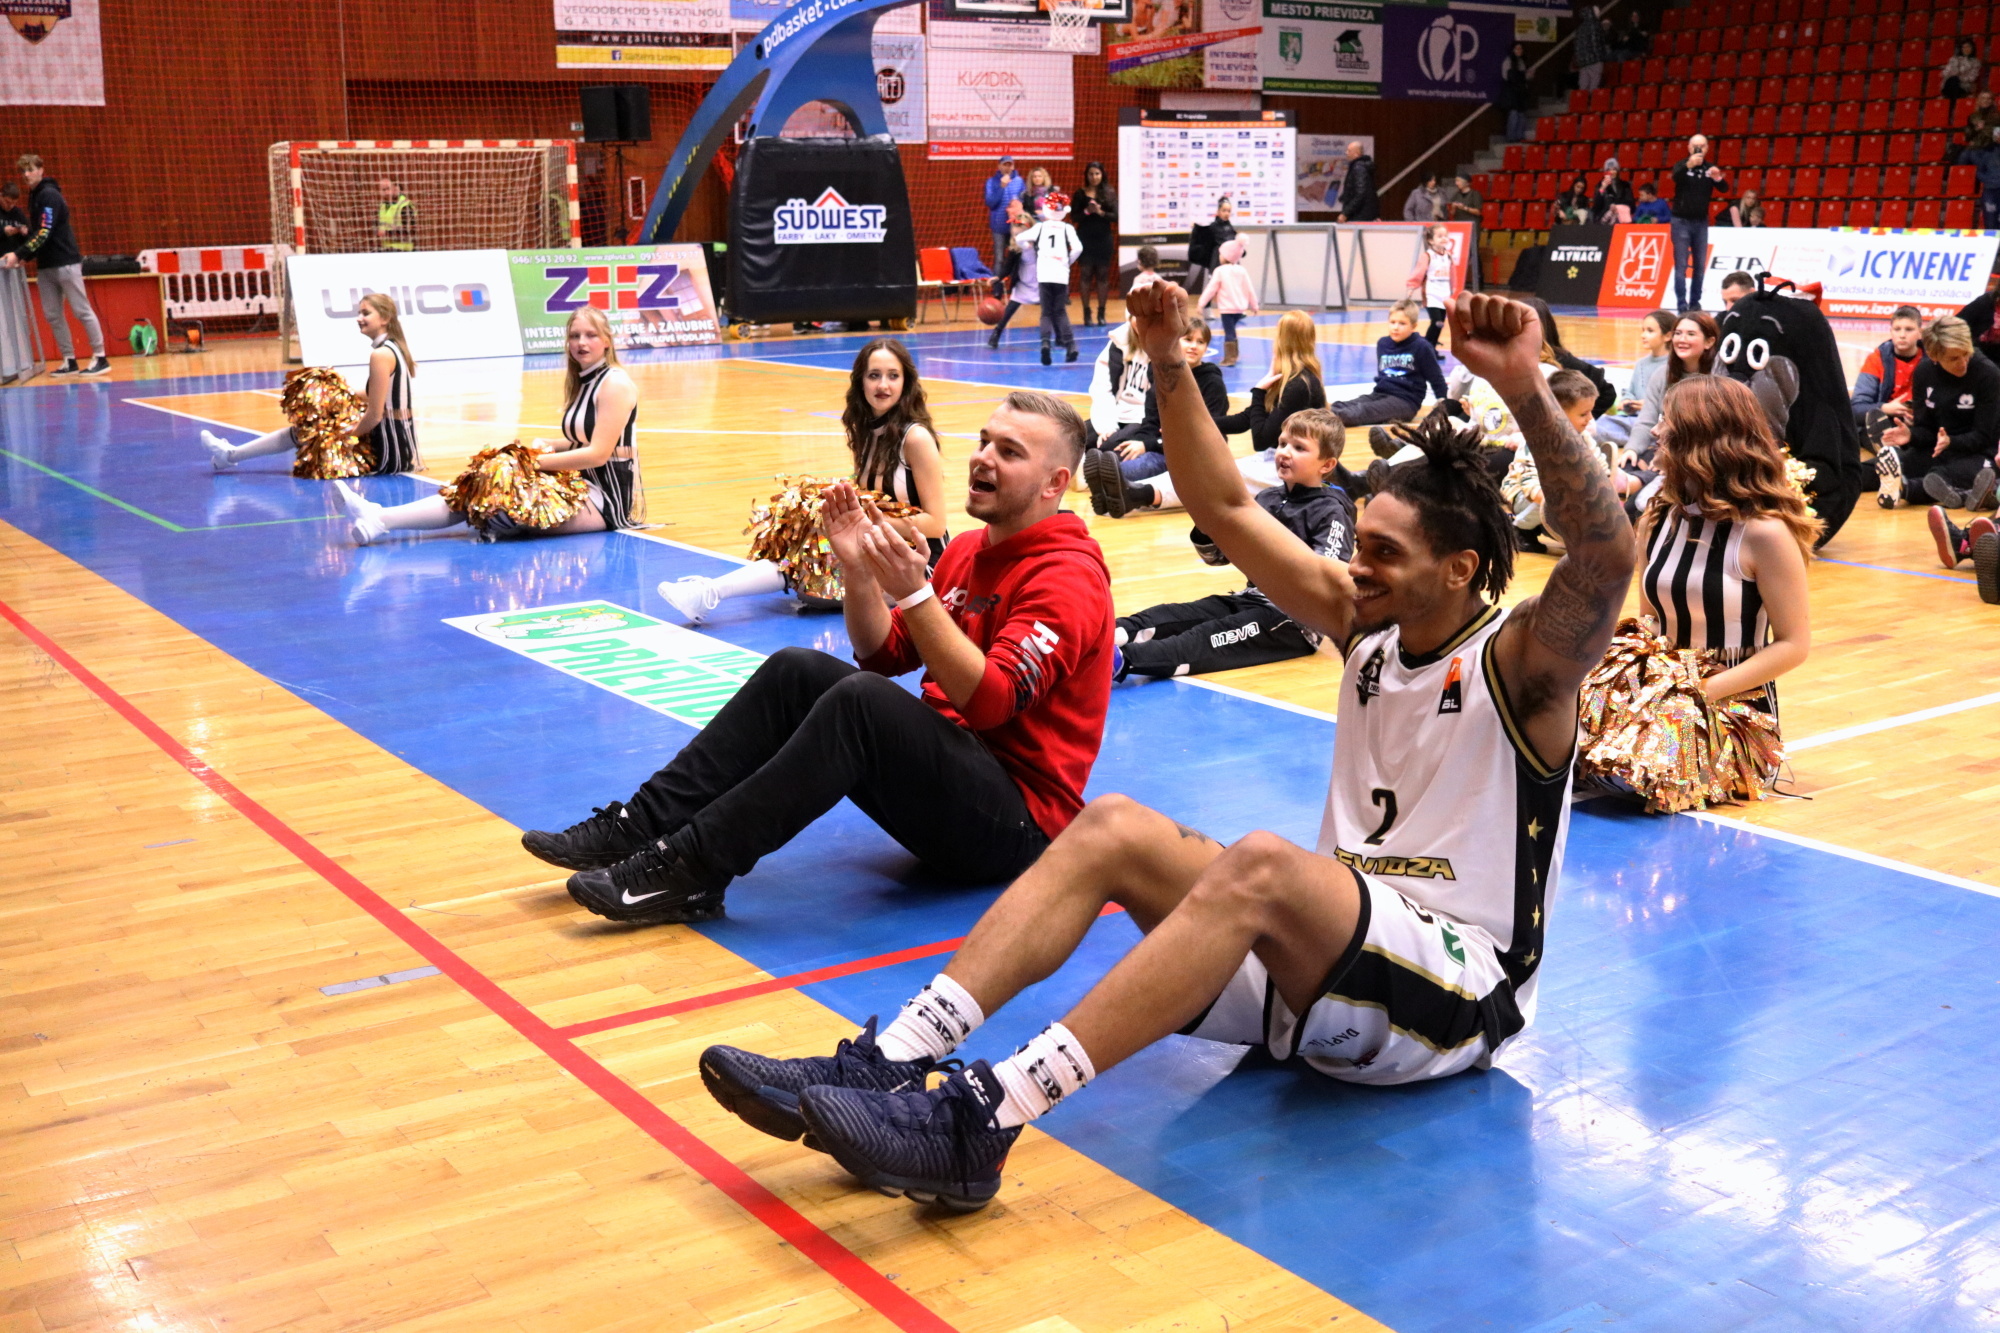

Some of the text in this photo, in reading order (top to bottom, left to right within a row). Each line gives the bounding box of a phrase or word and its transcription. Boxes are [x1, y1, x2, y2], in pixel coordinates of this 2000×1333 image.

[1271, 3, 1375, 20] MESTO PRIEVIDZA
[763, 0, 857, 58] pdbasket.c
[777, 202, 883, 231] SÜDWEST
[778, 231, 883, 241] FARBY LAKY OMIETKY
[1048, 234, 1056, 248] 1
[535, 254, 552, 263] 543
[554, 254, 565, 263] 20
[566, 254, 578, 263] 92
[1860, 250, 1976, 282] ICYNENE
[1615, 285, 1656, 300] Stavby
[524, 326, 567, 339] INTERI
[648, 321, 657, 333] A
[1210, 621, 1261, 648] meva
[524, 638, 744, 728] PRIEVID
[1364, 788, 1398, 845] 2
[1333, 845, 1457, 881] EVIDZA
